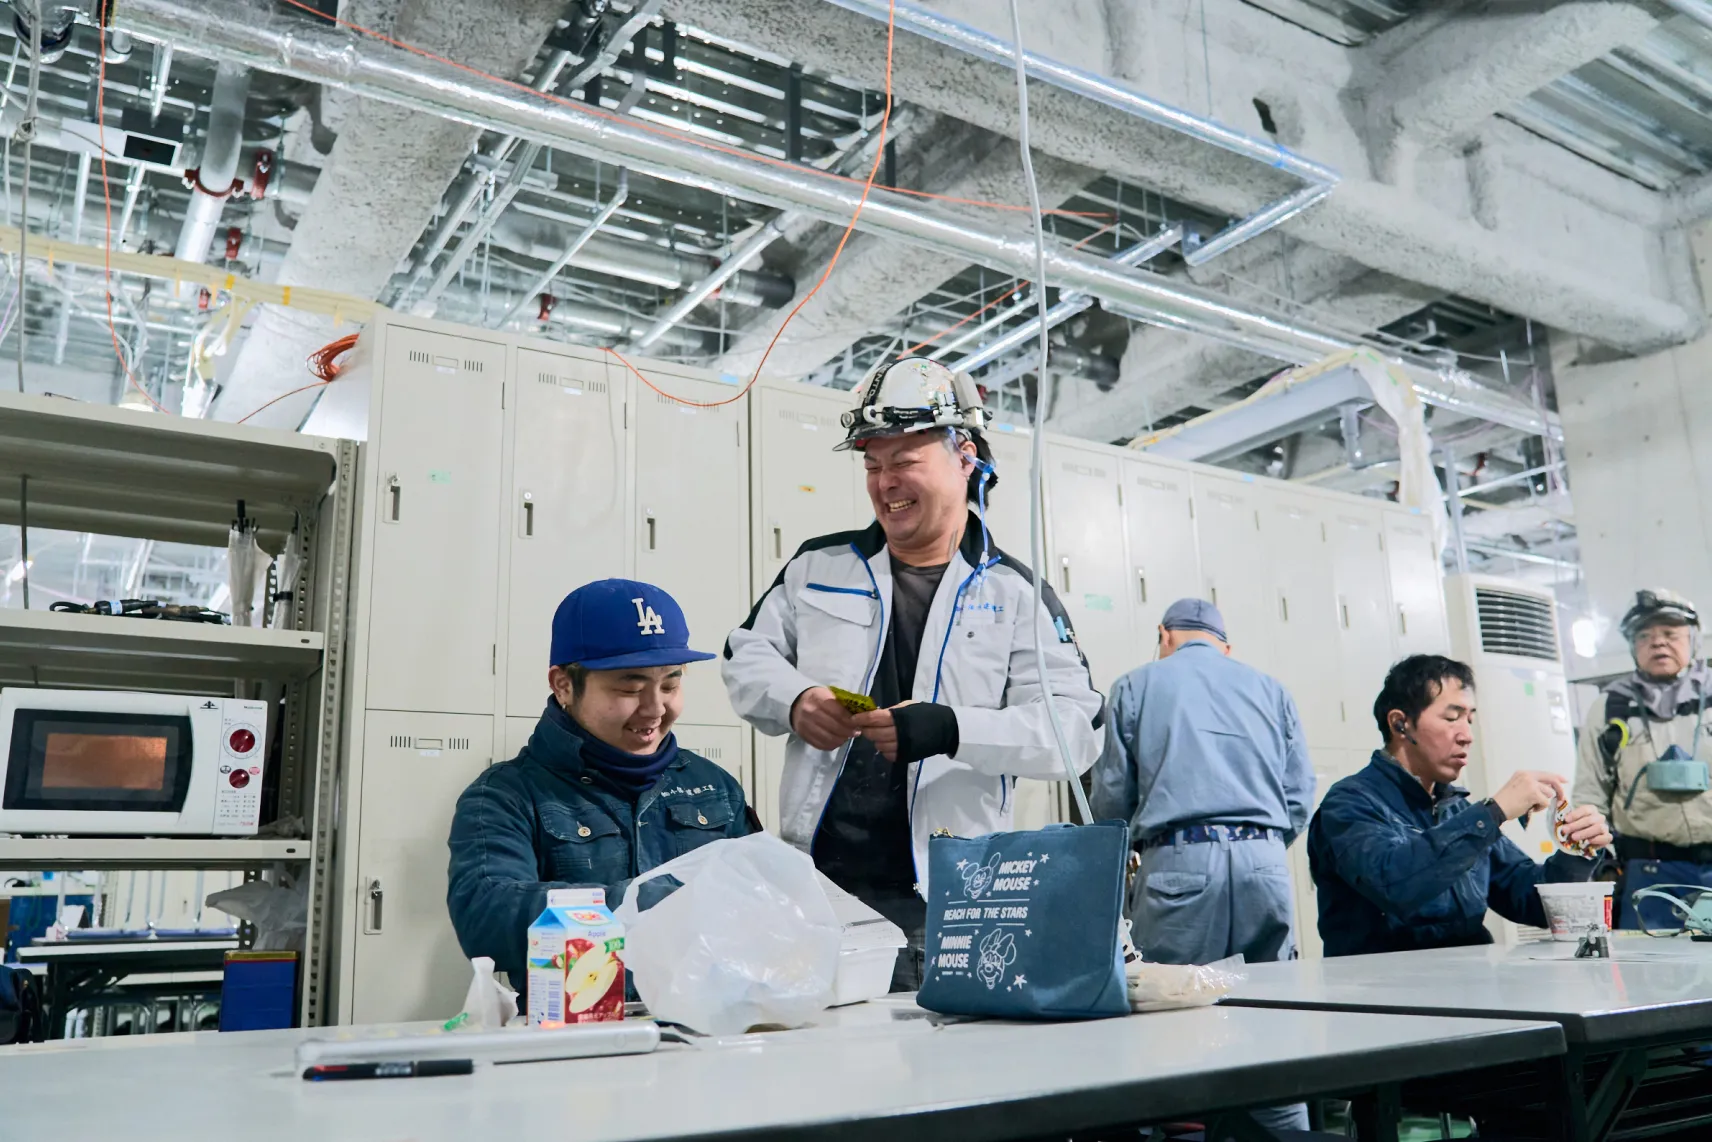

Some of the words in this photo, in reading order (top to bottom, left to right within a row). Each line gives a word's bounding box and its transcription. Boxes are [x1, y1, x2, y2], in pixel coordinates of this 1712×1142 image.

[631, 597, 665, 635] LA
[999, 860, 1037, 874] MICKEY
[992, 877, 1031, 892] MOUSE
[943, 907, 967, 921] REACH
[967, 906, 981, 920] FOR
[983, 906, 1000, 919] THE
[1000, 906, 1029, 919] STARS
[587, 930, 606, 938] Apple
[940, 935, 972, 950] MINNIE
[937, 953, 969, 968] MOUSE
